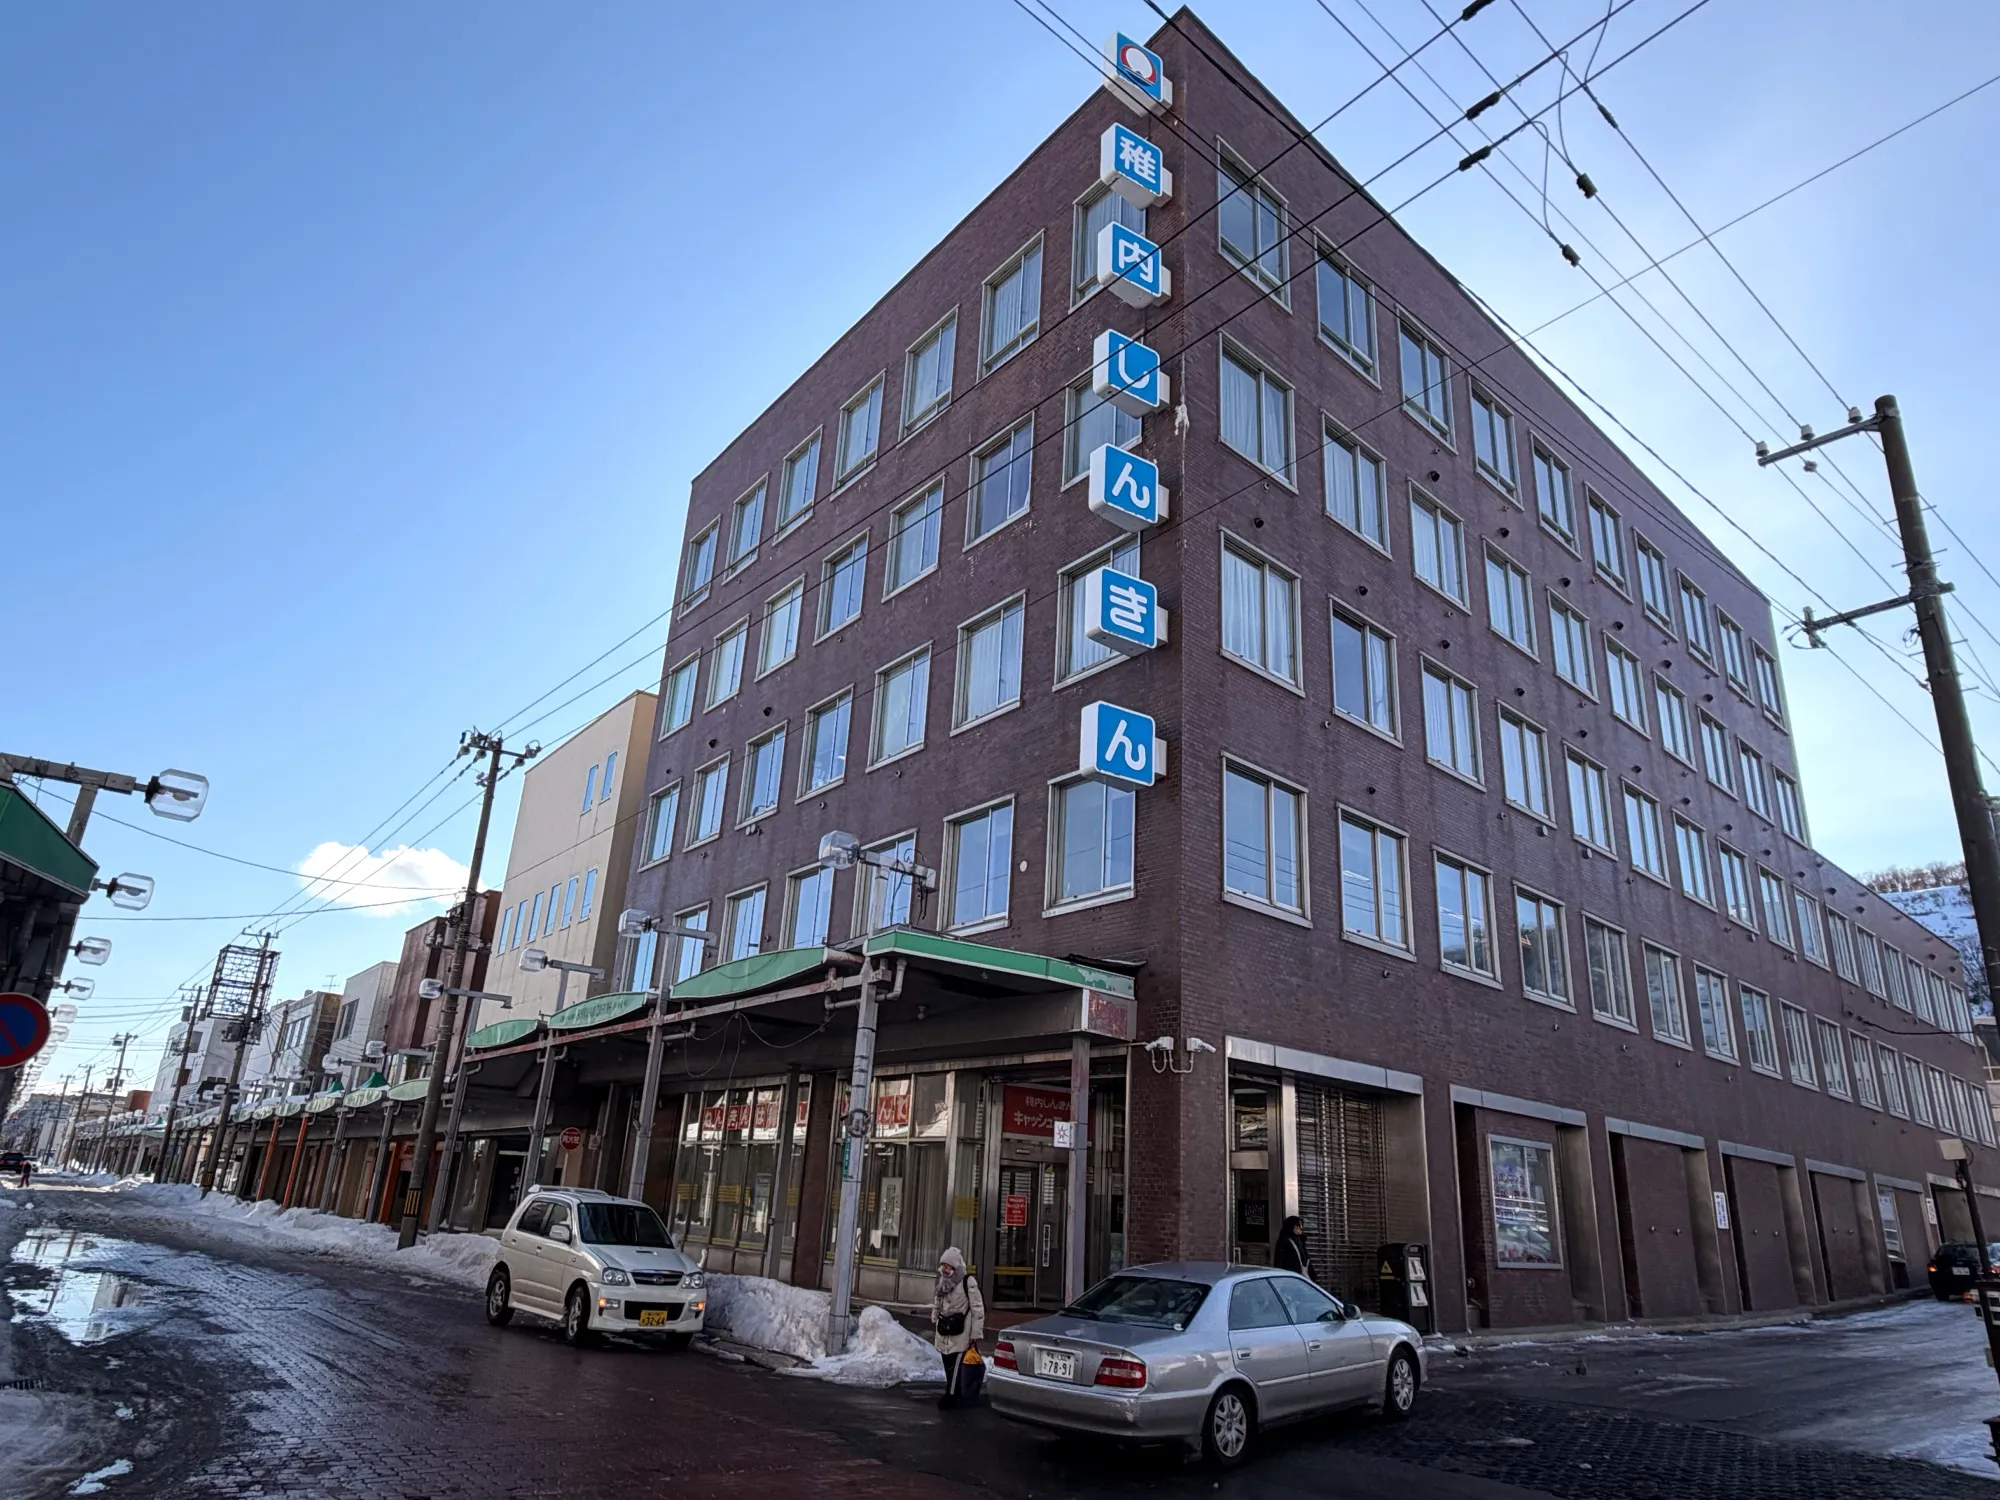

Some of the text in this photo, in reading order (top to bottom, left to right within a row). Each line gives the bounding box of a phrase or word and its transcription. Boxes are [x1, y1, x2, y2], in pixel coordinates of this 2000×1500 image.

[1105, 135, 1157, 770] 稚内しんきん
